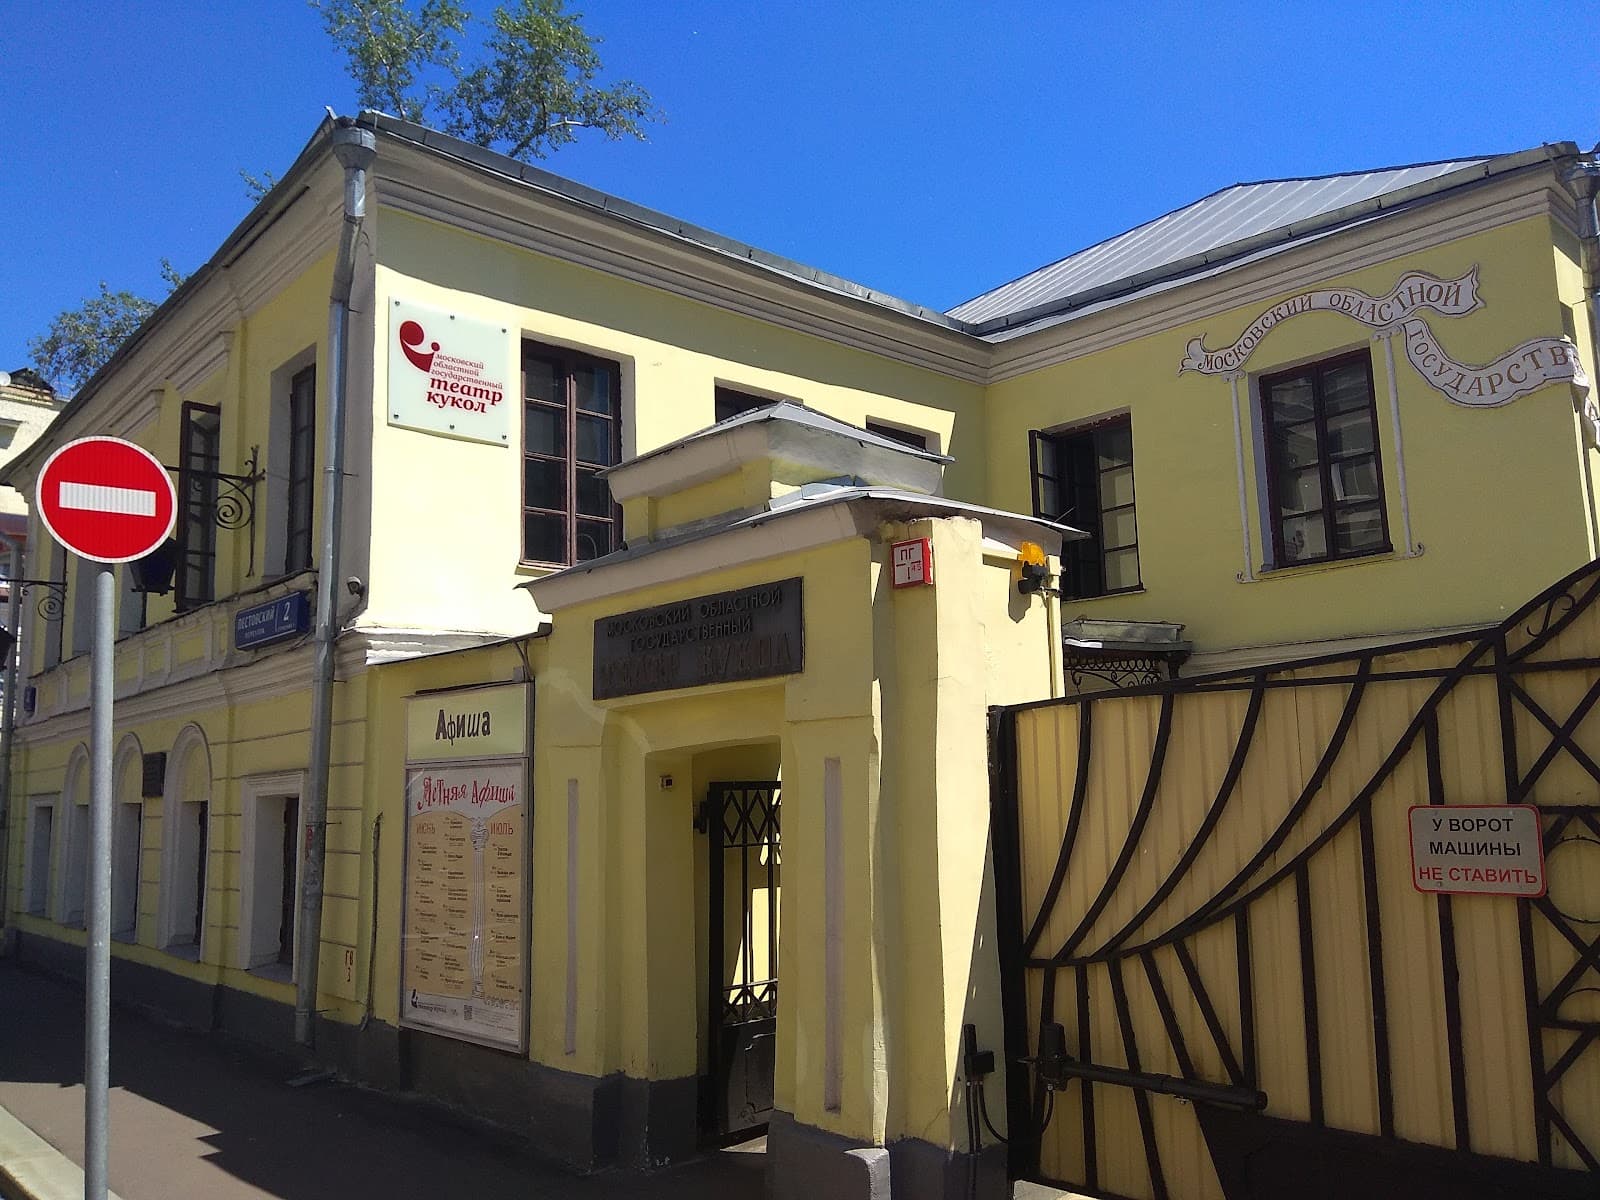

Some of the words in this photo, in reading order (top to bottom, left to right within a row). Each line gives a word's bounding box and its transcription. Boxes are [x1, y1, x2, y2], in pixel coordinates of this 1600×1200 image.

[1198, 294, 1313, 371] МОСКОВСКИЙ
[1329, 282, 1462, 323] ОБЛАСТНОЙ
[433, 361, 480, 377] областной
[435, 353, 485, 370] московский
[431, 369, 503, 390] государственный
[430, 377, 503, 406] театр
[426, 391, 487, 413] кукол
[900, 547, 914, 561] ПГ
[283, 601, 291, 621] 2
[607, 604, 692, 638] МОСКОВСКИЙ
[700, 587, 782, 618] ОБЛАСТНОЙ
[630, 615, 753, 653] ГОСУДАРСТВЕННЫЙ
[435, 709, 491, 746] Афиша
[490, 821, 514, 836] ИЮЛЬ
[1432, 818, 1442, 831] У
[1449, 818, 1514, 832] ВОРОТ
[1429, 841, 1521, 856] МАШИНЫ
[1419, 866, 1443, 881] НЕ
[1448, 867, 1538, 884] СТАВИТЬ
